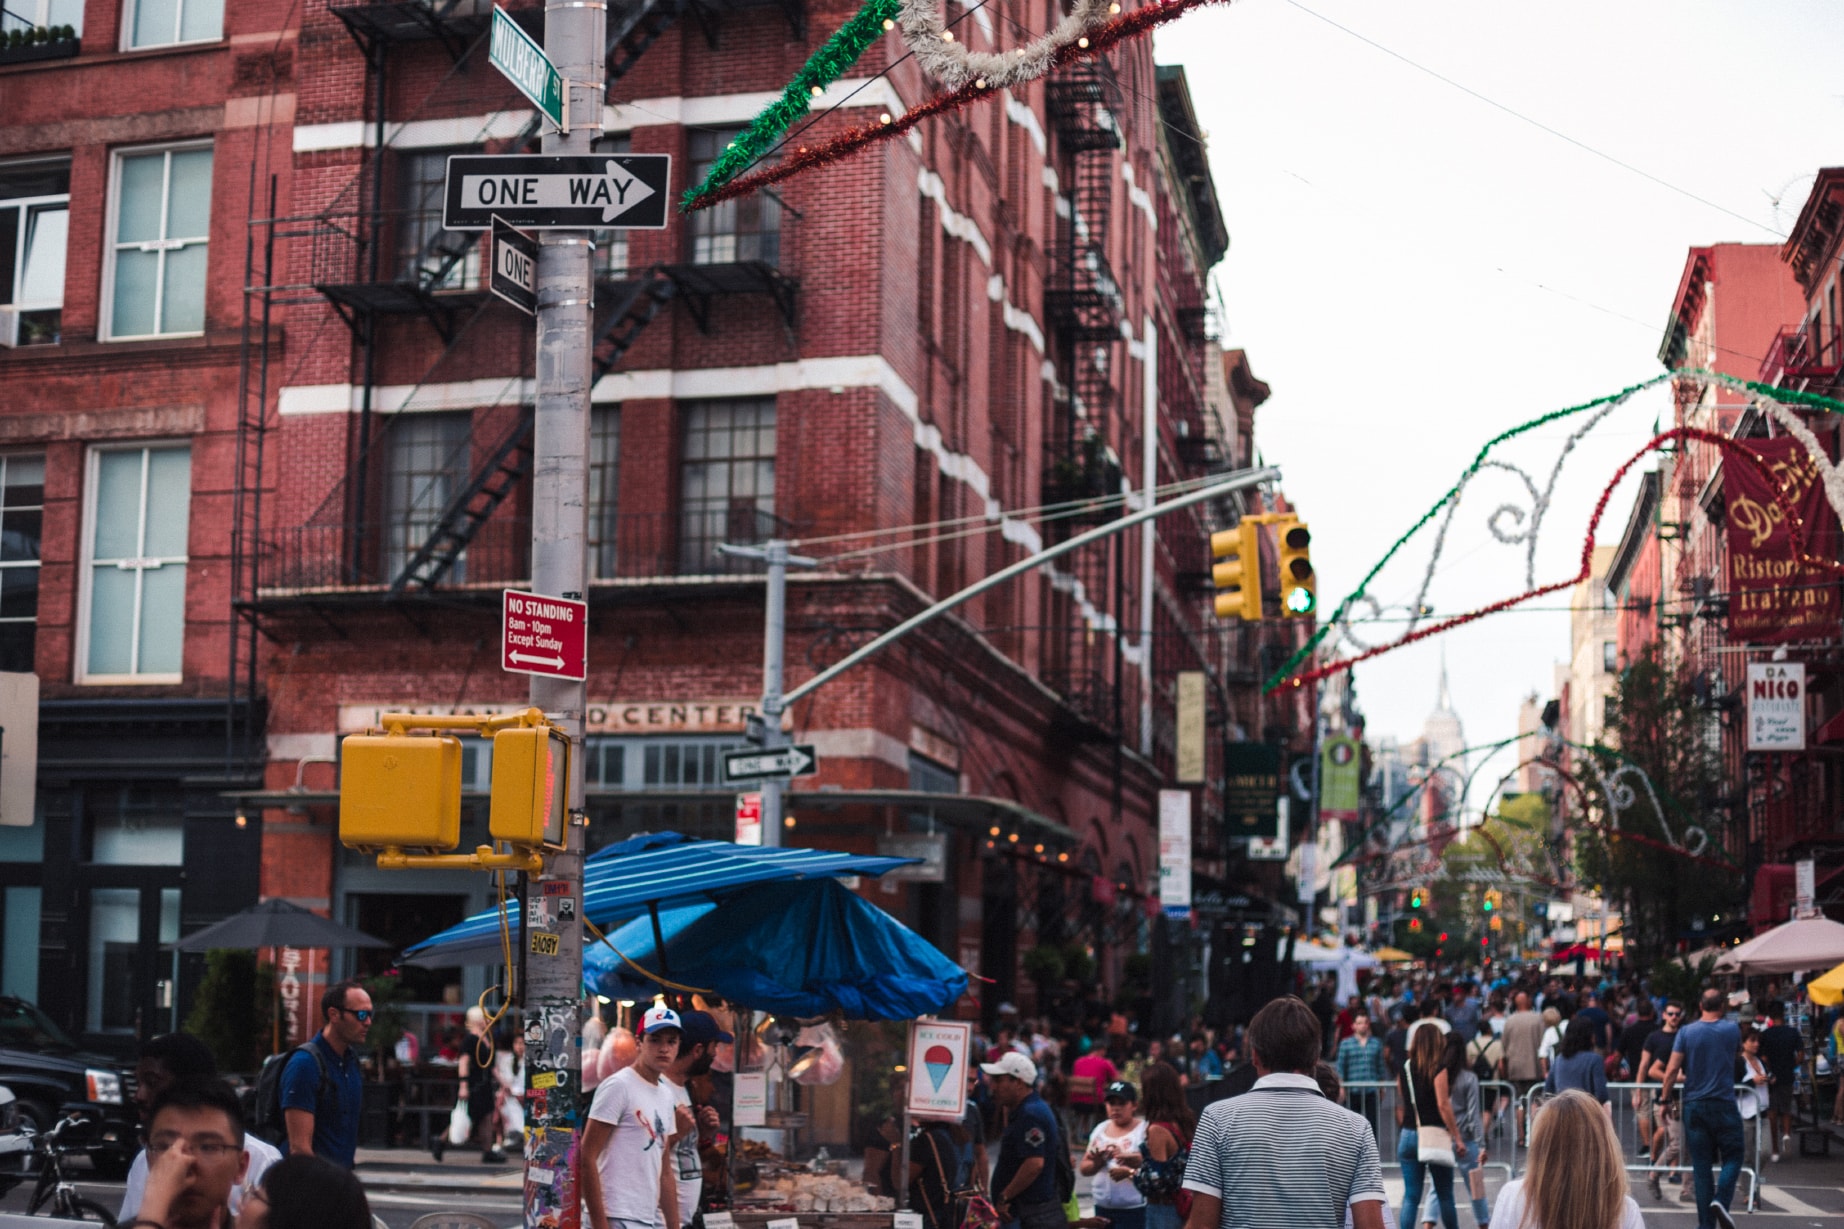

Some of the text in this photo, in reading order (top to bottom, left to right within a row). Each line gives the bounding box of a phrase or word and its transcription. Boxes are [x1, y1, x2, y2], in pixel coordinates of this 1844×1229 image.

[494, 15, 561, 104] MULBERRY ST
[479, 178, 634, 205] ONE WAY
[505, 248, 531, 288] ONE
[509, 598, 574, 623] NO STANDING
[508, 617, 526, 631] 8am
[531, 620, 552, 636] 10pm
[508, 631, 563, 653] Except Sunday
[1766, 667, 1787, 678] DA
[1754, 680, 1799, 700] NICO
[531, 934, 558, 954] ABOVE
